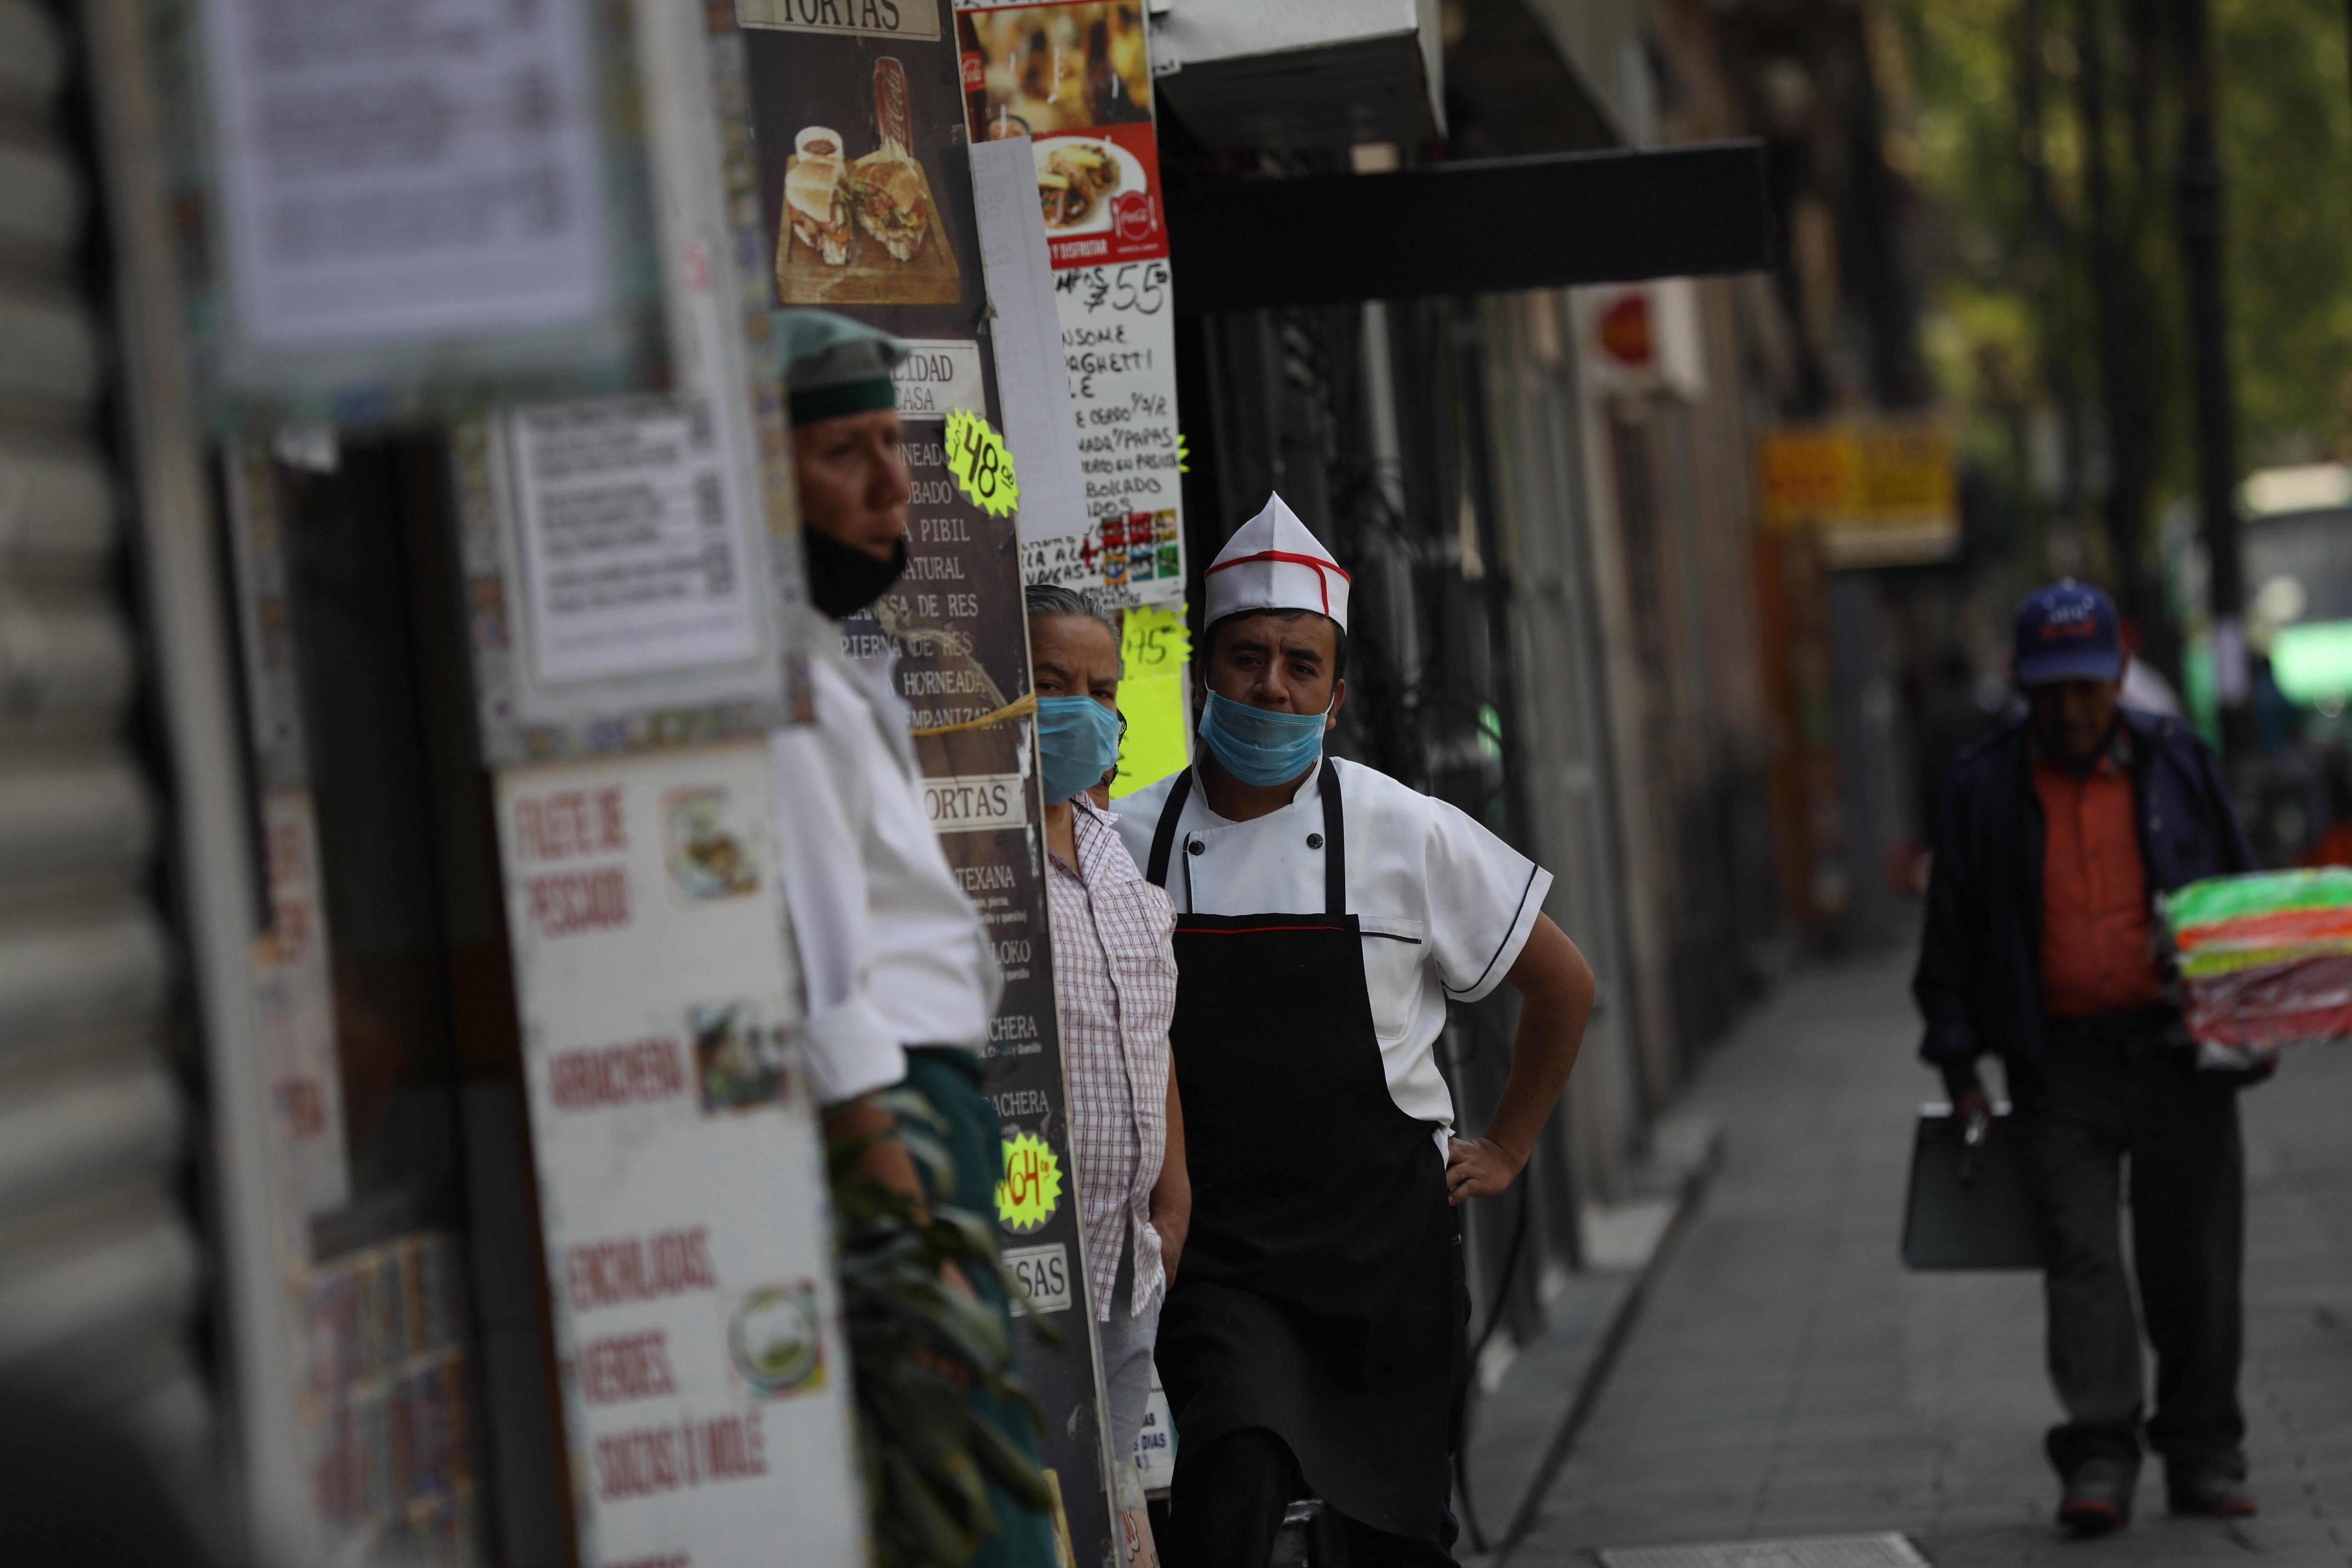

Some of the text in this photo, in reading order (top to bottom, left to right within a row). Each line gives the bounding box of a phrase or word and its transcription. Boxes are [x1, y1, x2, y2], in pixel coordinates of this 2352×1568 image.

[1060, 238, 1109, 259] DISFRUTAR
[894, 387, 934, 410] CASA
[920, 518, 970, 542] PIBIL
[901, 557, 965, 580] ATURAL
[918, 594, 940, 618] DE
[947, 593, 979, 617] RES
[840, 633, 903, 659] PIERNA
[903, 670, 986, 696] HORNEADA
[954, 865, 1016, 891] TEXANA
[985, 1015, 1038, 1042] CHERA
